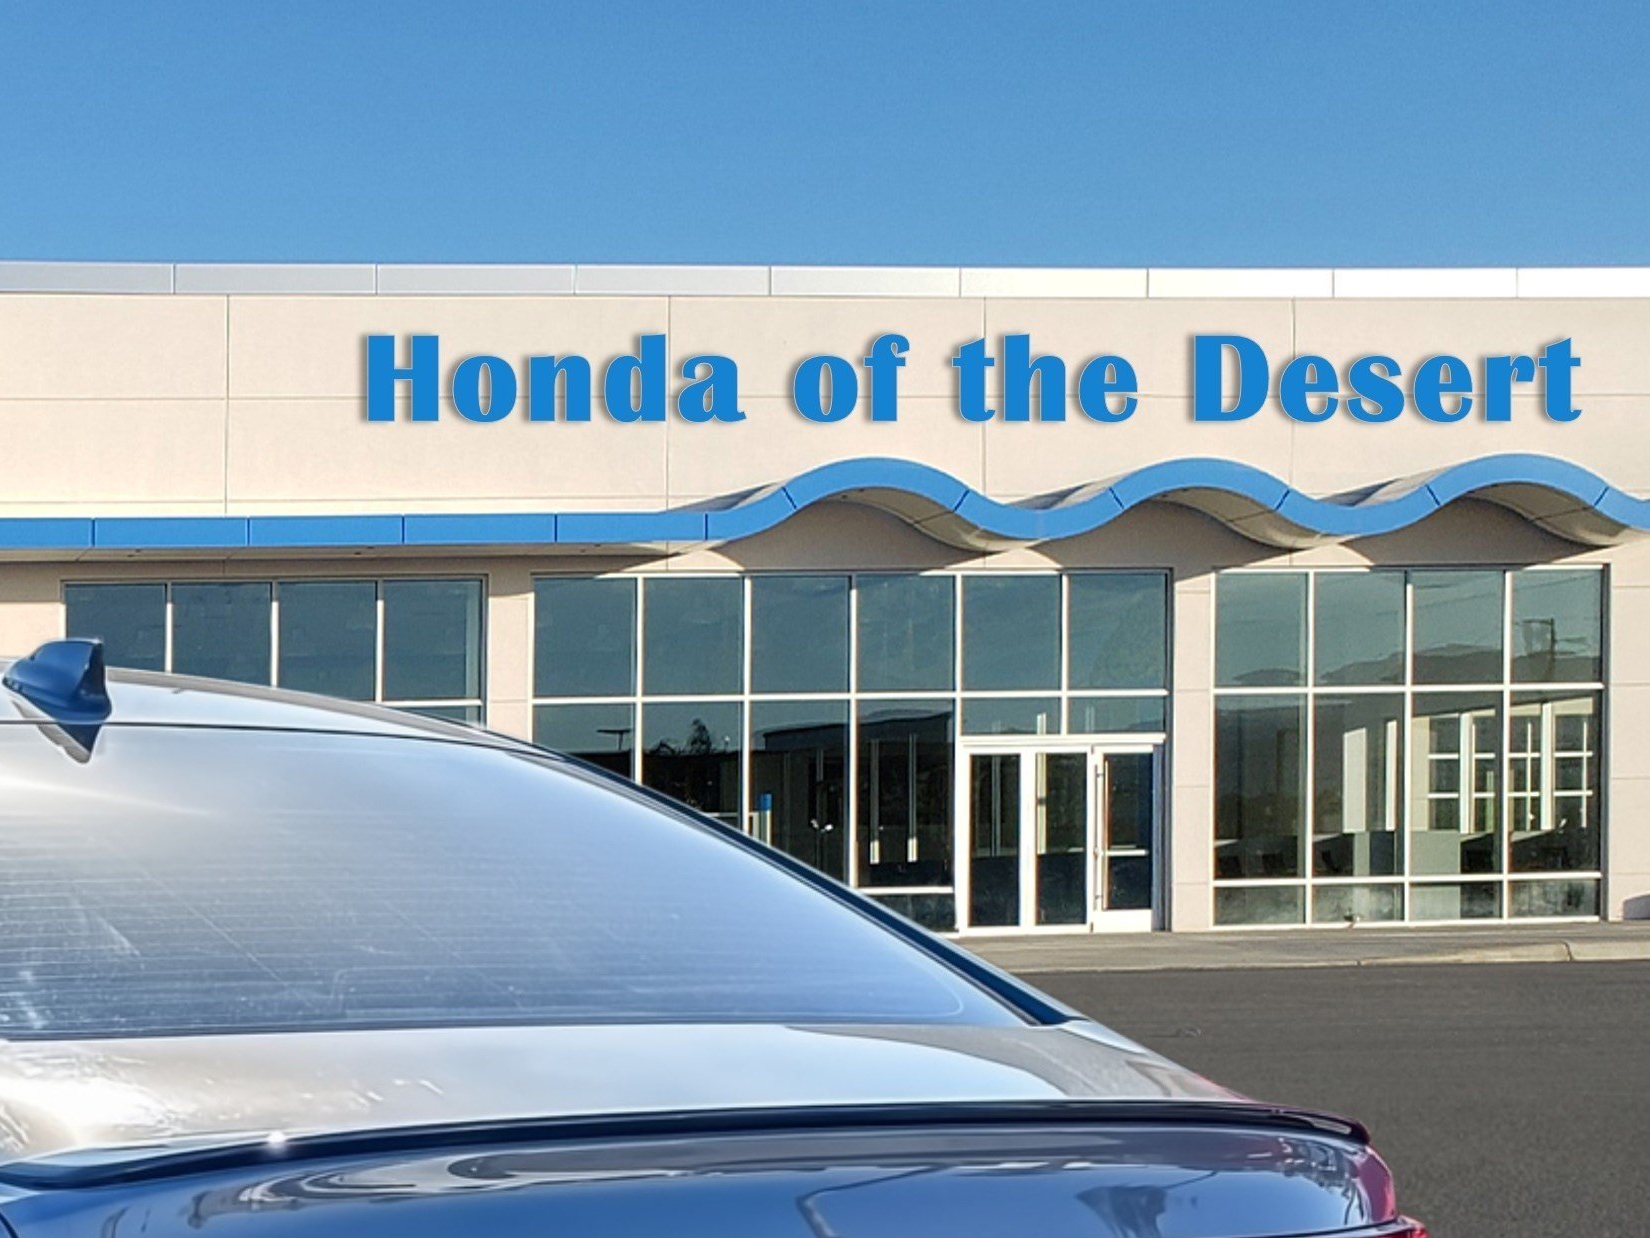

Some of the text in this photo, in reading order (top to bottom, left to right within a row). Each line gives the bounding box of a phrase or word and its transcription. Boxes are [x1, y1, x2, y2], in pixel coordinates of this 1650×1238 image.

[365, 333, 1583, 424] Honda of the Desert
